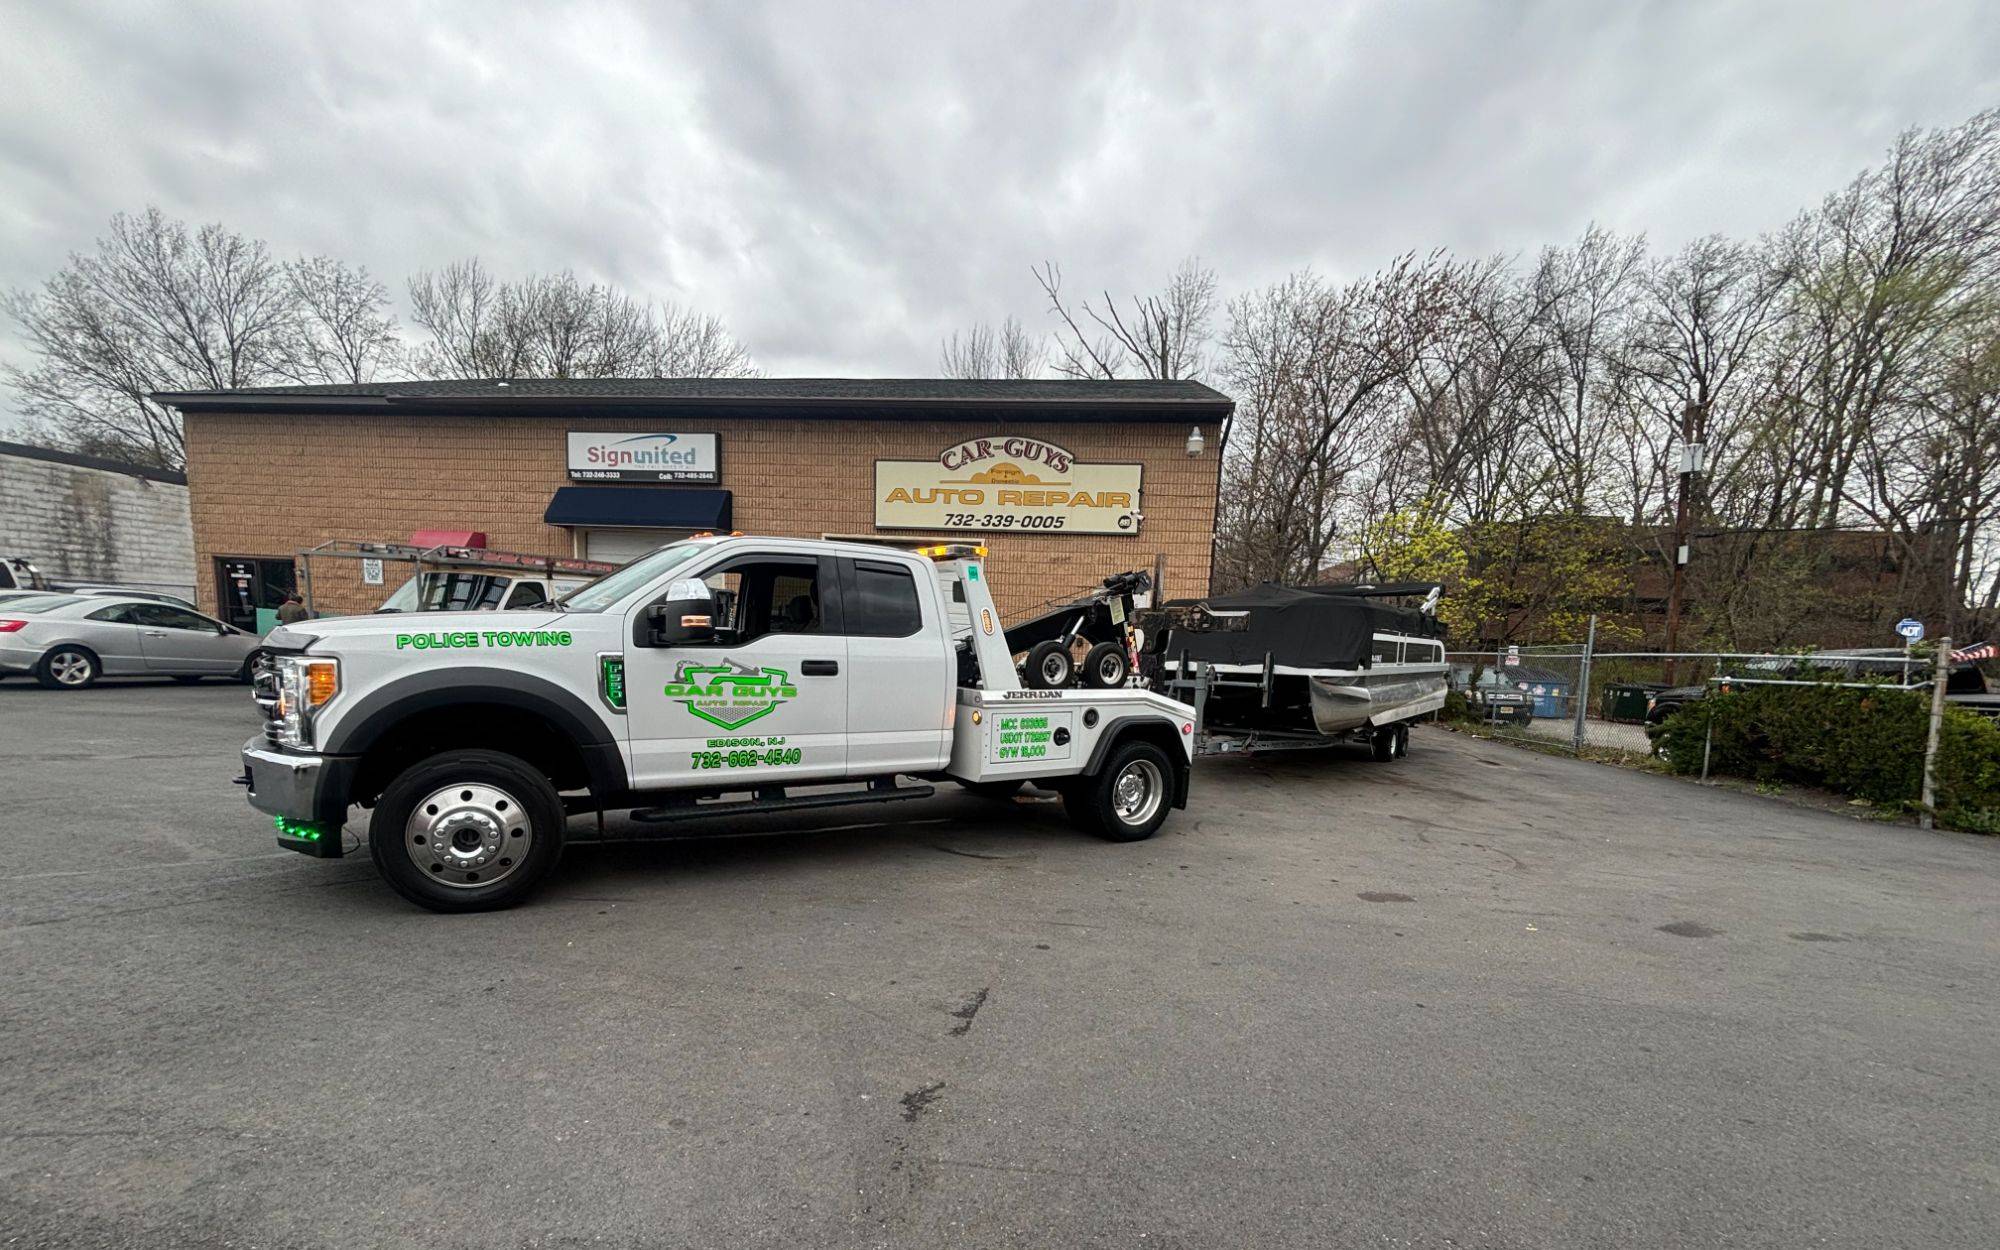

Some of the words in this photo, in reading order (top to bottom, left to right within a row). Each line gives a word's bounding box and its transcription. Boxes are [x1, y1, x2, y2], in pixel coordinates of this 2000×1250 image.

[587, 445, 696, 467] Signunited
[941, 438, 1072, 473] CAR-GUYS
[885, 487, 985, 505] AUTO
[998, 490, 1131, 508] REPAIR
[944, 513, 1066, 529] 732-339-0005
[396, 632, 479, 649] POLICE
[483, 631, 572, 647] TOWING
[1901, 626, 1921, 637] ADT
[664, 684, 724, 697] CAR
[732, 686, 798, 698] GUYS
[707, 738, 765, 748] EDISON,
[767, 737, 786, 745] NJ
[1000, 731, 1023, 744] USDOT
[691, 748, 802, 770] 732-662-4540
